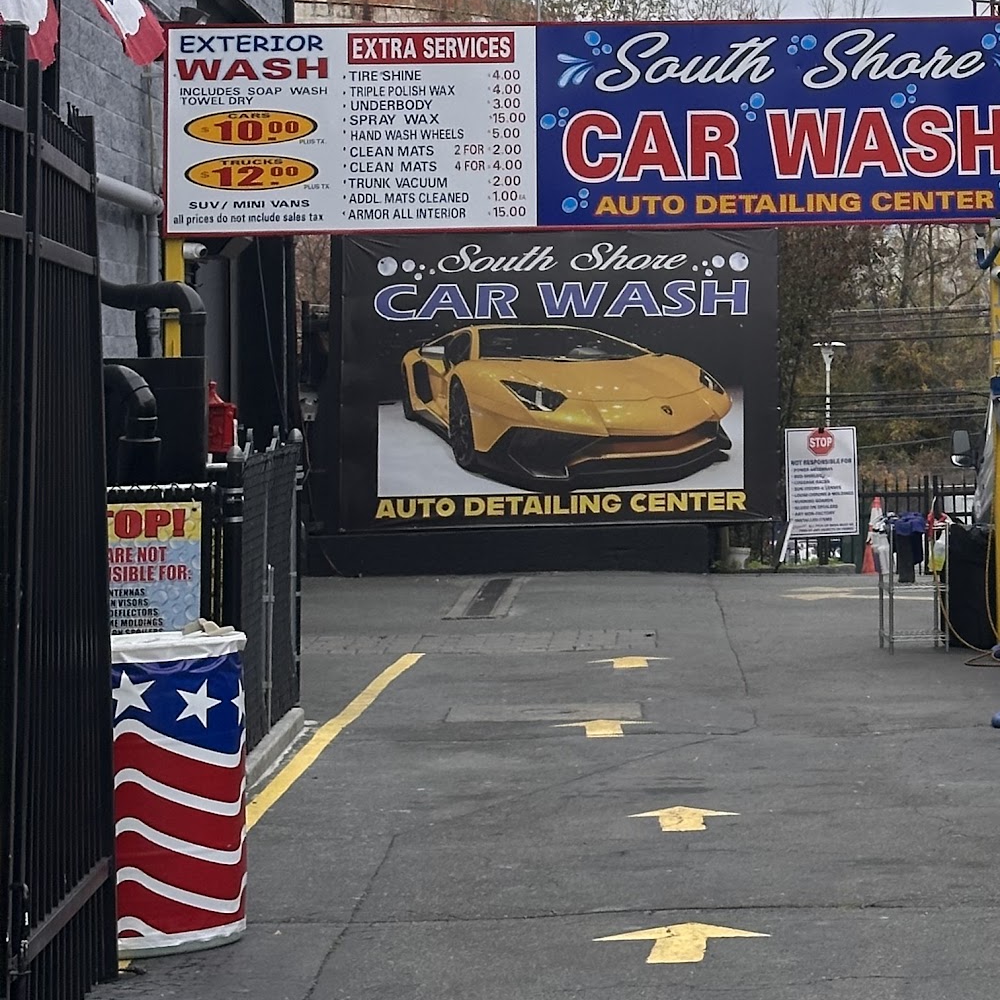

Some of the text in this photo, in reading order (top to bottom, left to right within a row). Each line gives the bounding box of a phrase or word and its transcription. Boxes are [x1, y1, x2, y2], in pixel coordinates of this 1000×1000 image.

[180, 35, 323, 53] EXTERIOR
[352, 37, 510, 59] EXTRA SERVICES
[595, 28, 986, 92] South Shore
[176, 58, 328, 80] WASH
[349, 70, 421, 81] TIRE SHINE
[180, 88, 240, 96] INCLUDES
[290, 87, 327, 95] WASH
[350, 85, 455, 97] TRIPLE POLISH WAX
[180, 97, 225, 105] TOWEL
[351, 100, 432, 110] UNDERBODY
[350, 114, 439, 125] SPRAY WAX
[351, 129, 464, 141] HAND WASH WHEELS
[350, 145, 484, 157] CLEAN MATS 2 FOR
[561, 109, 742, 184] CAR
[350, 161, 485, 172] CLEAN MATS 4 FOR
[348, 177, 447, 188] TRUNK VACUUM
[385, 193, 469, 203] MATS CLEANED
[594, 190, 996, 215] AUTO DETAILING CENTER
[189, 201, 228, 209] SUV/
[174, 212, 323, 226] all prices do not include sales tax
[348, 208, 465, 220] ARMOR ALL INTERIOR
[438, 243, 687, 273] South Shore
[374, 280, 750, 321] CAR WASH
[810, 437, 832, 448] STOP
[375, 492, 747, 519] AUTO DETAILING CENTER
[107, 509, 185, 538] OP!
[138, 547, 166, 561] NOT
[159, 565, 192, 581] FOR:
[121, 619, 163, 627] MOLDINGS
